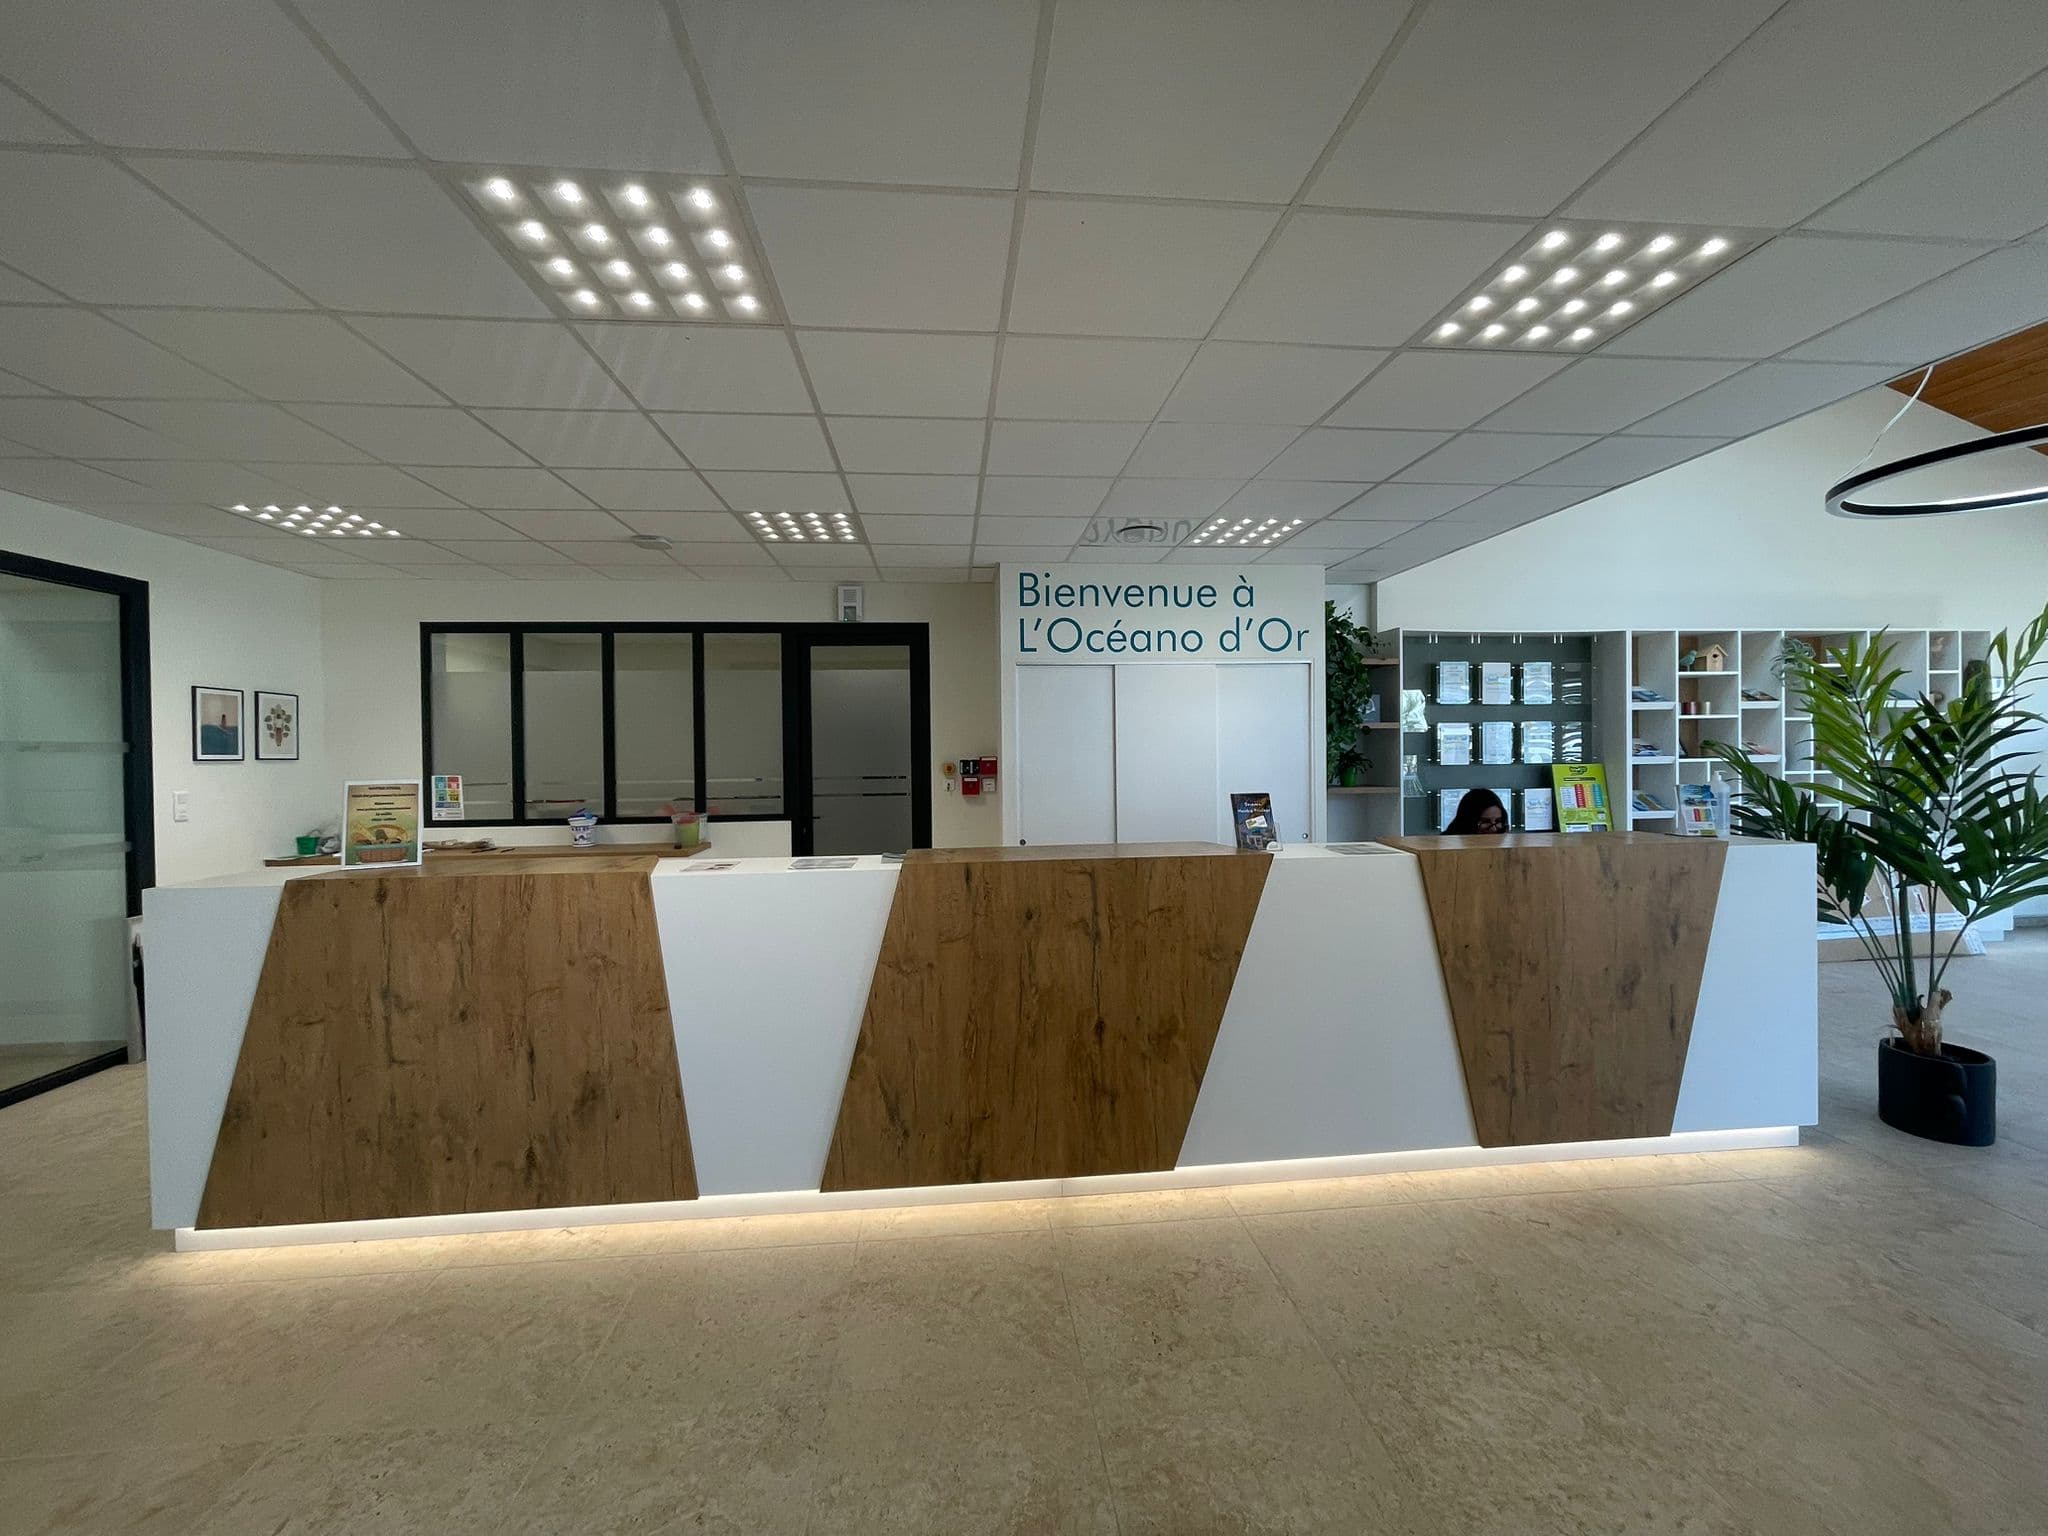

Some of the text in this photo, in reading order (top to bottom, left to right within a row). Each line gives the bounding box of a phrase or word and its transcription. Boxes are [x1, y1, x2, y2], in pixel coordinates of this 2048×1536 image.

[1018, 572, 1254, 608] Bienvenue à
[1019, 616, 1309, 653] L'Océano d'Or
